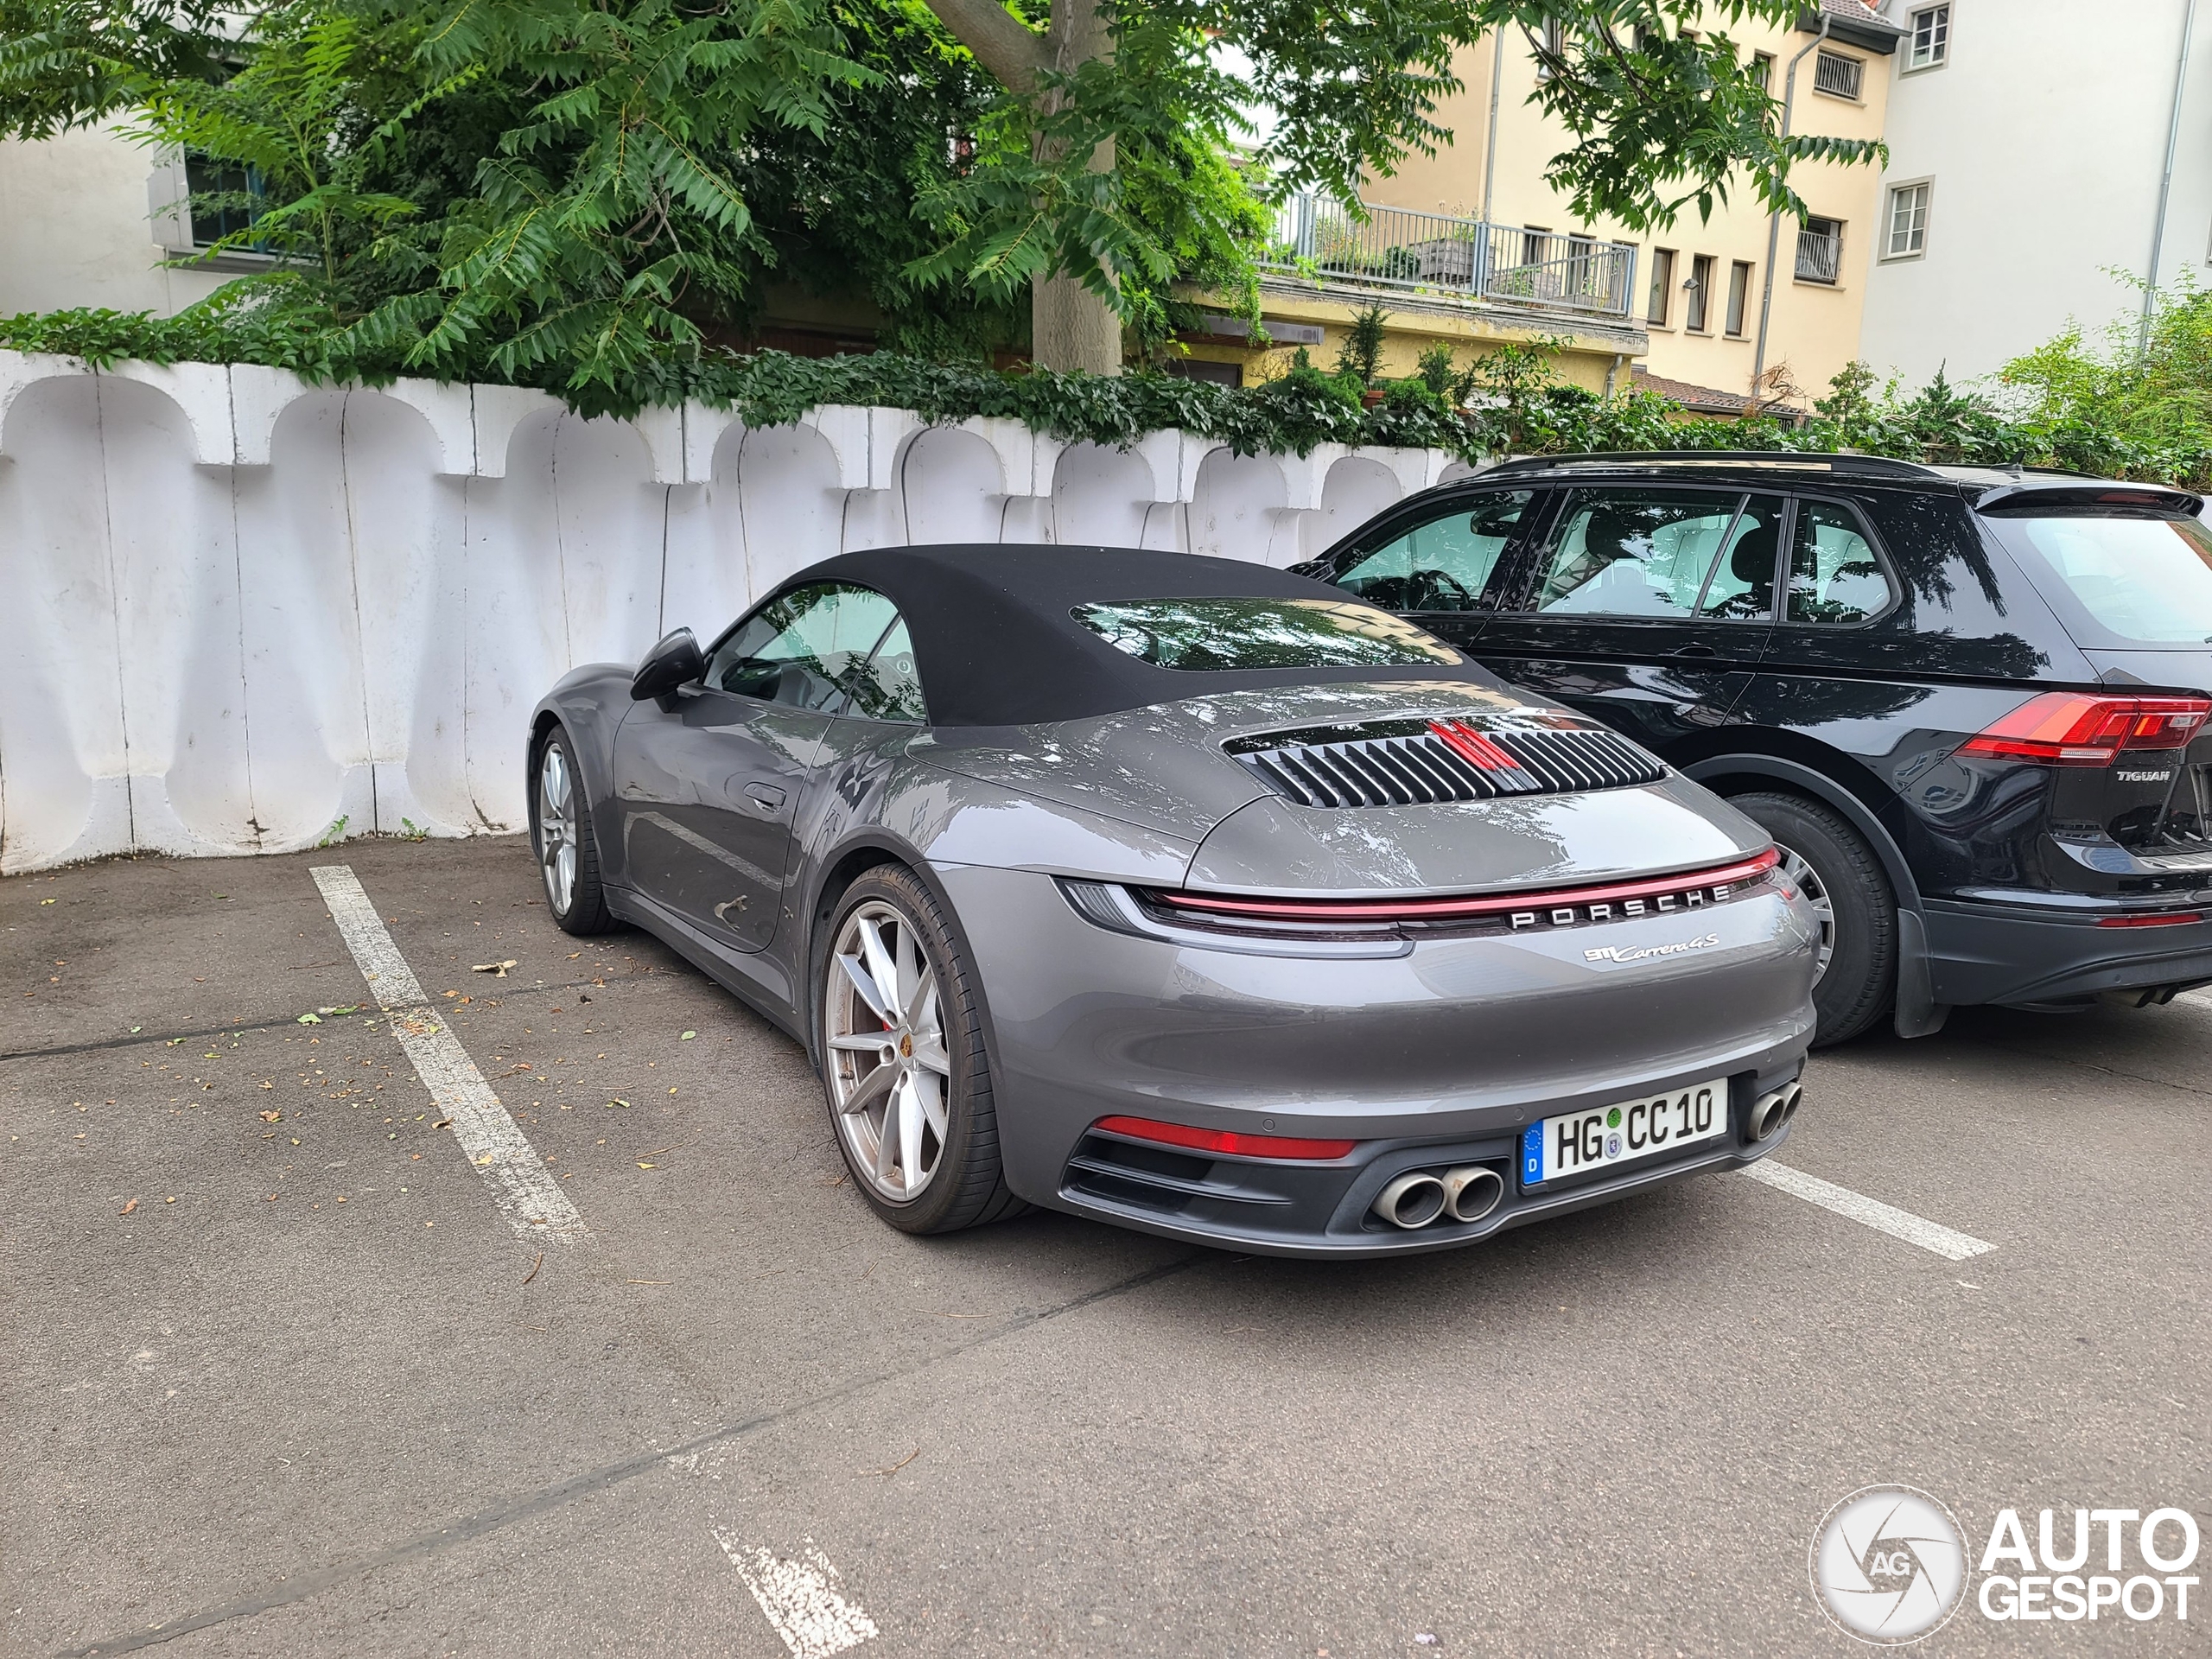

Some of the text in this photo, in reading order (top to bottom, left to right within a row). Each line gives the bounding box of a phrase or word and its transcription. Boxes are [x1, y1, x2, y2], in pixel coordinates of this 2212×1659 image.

[2117, 771, 2171, 781] TIGUAN
[1511, 885, 1729, 929] PORSCHE
[910, 908, 935, 950] EAGLE
[1584, 932, 1719, 963] 911 Carrera 4S
[1558, 1088, 1713, 1169] HG CC 10
[1529, 1158, 1537, 1173] D
